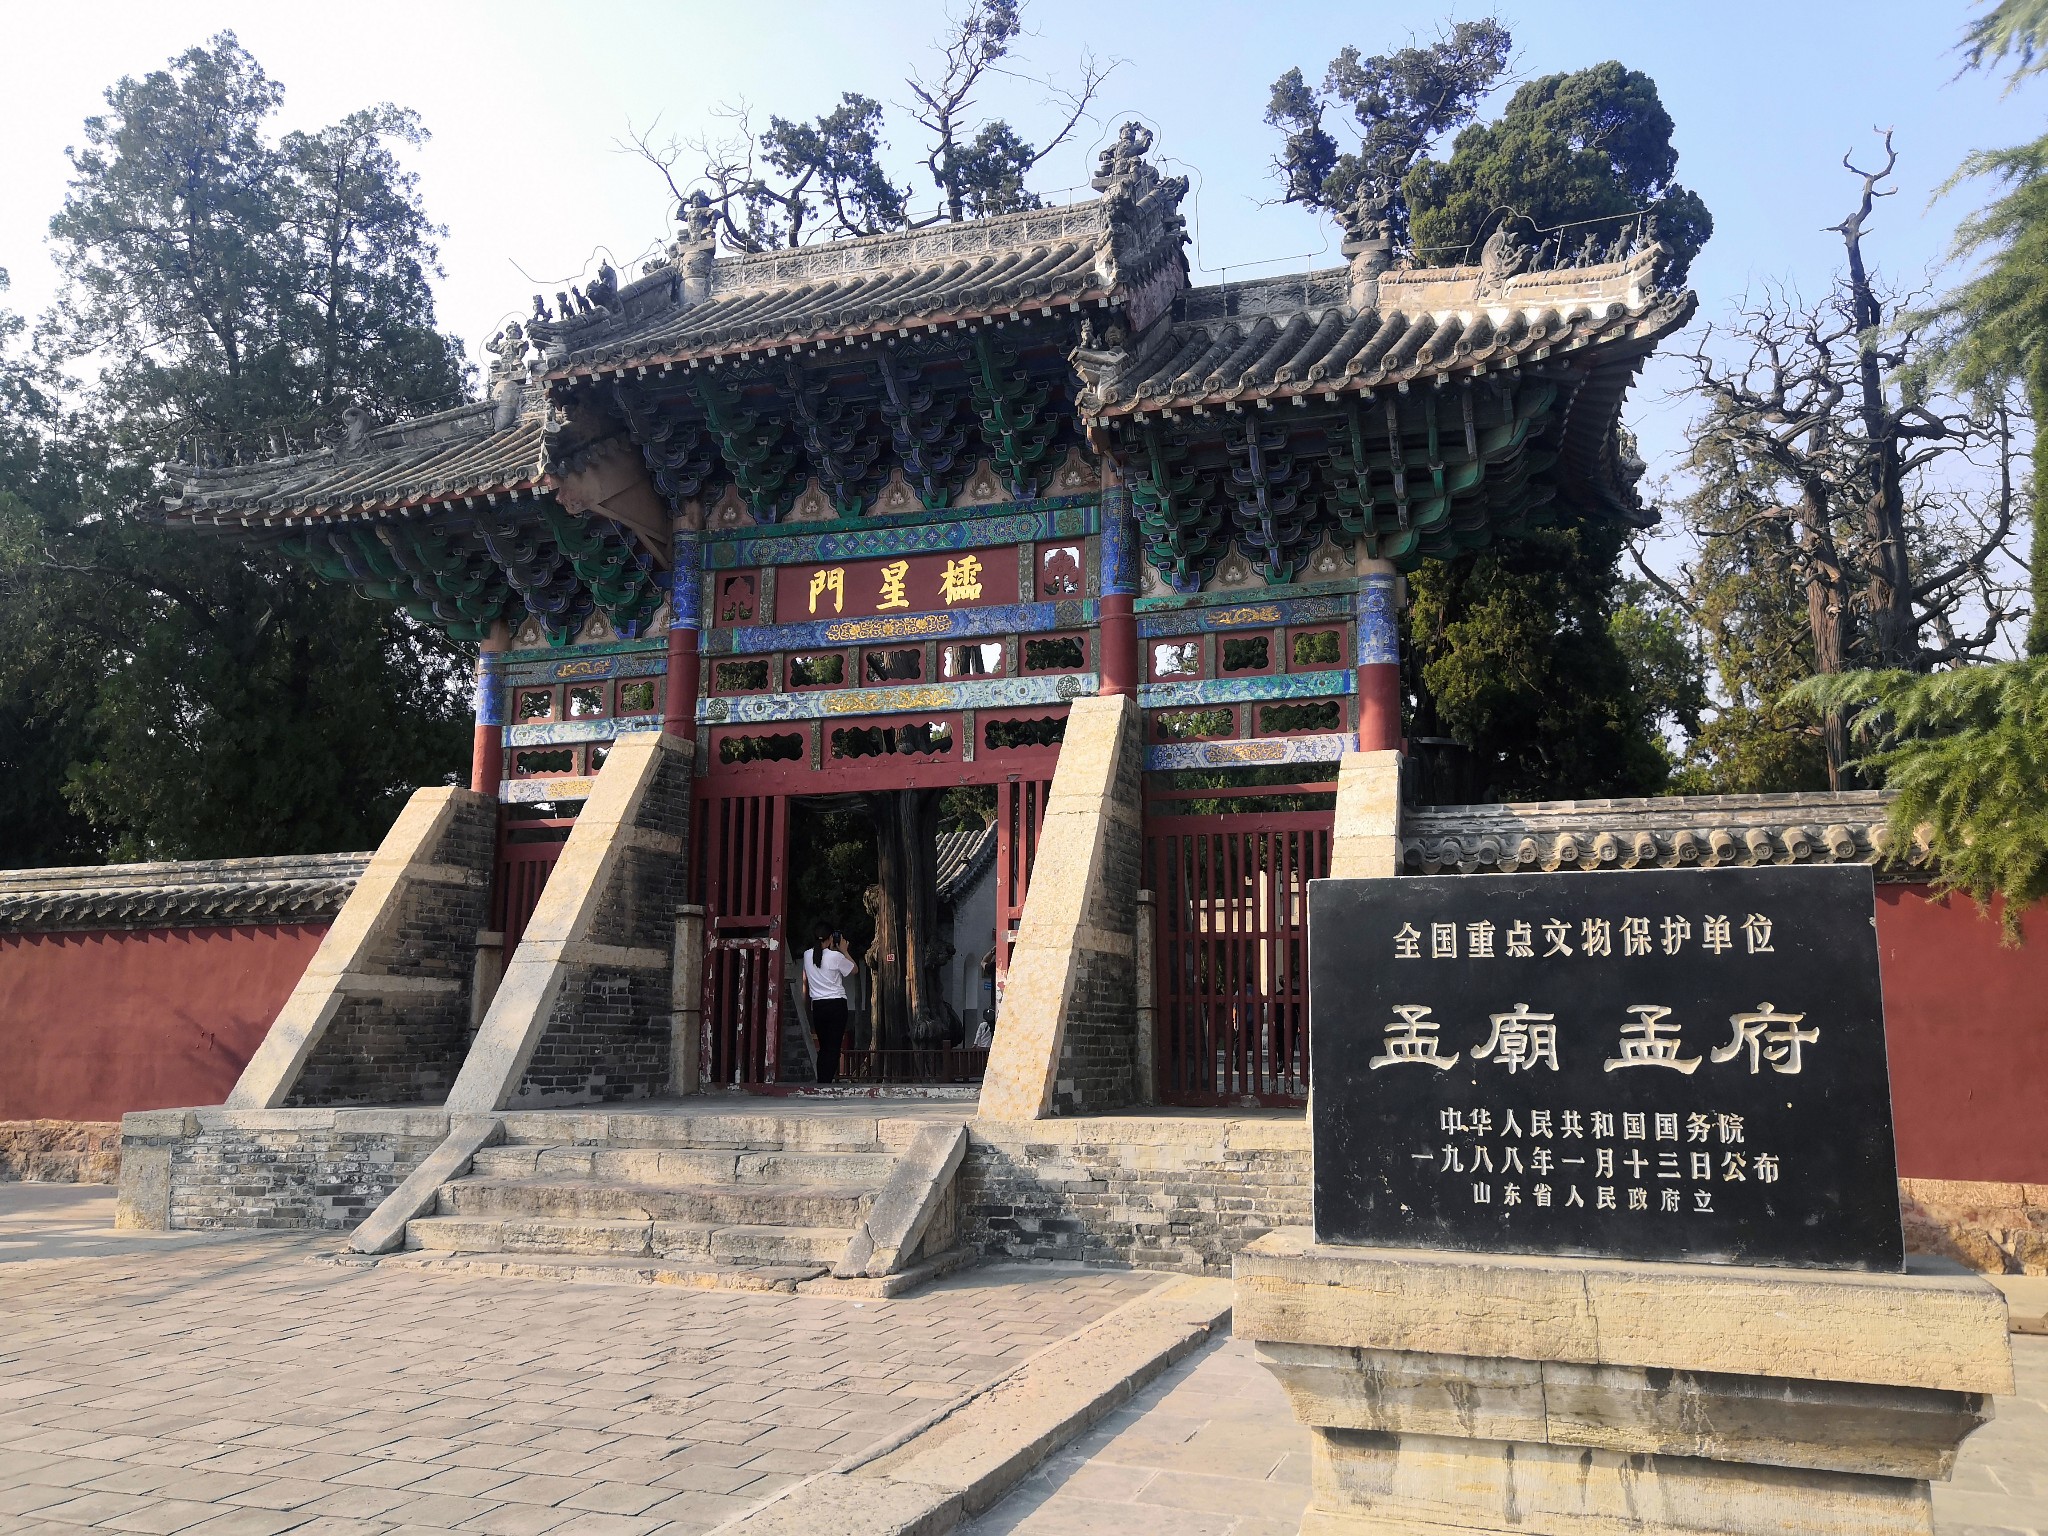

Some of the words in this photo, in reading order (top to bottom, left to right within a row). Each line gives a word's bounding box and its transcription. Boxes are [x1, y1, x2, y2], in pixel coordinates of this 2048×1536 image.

[1392, 913, 1775, 958] 全国重点文物保护单位
[1370, 1003, 1560, 1074] 孟廟
[1603, 1002, 1820, 1075] 孟府
[1440, 1108, 1745, 1144] 中华人民共和国国务院
[1411, 1144, 1780, 1184] 一九八八年一月十三日公布
[1473, 1181, 1714, 1213] 山东省人民政府立
